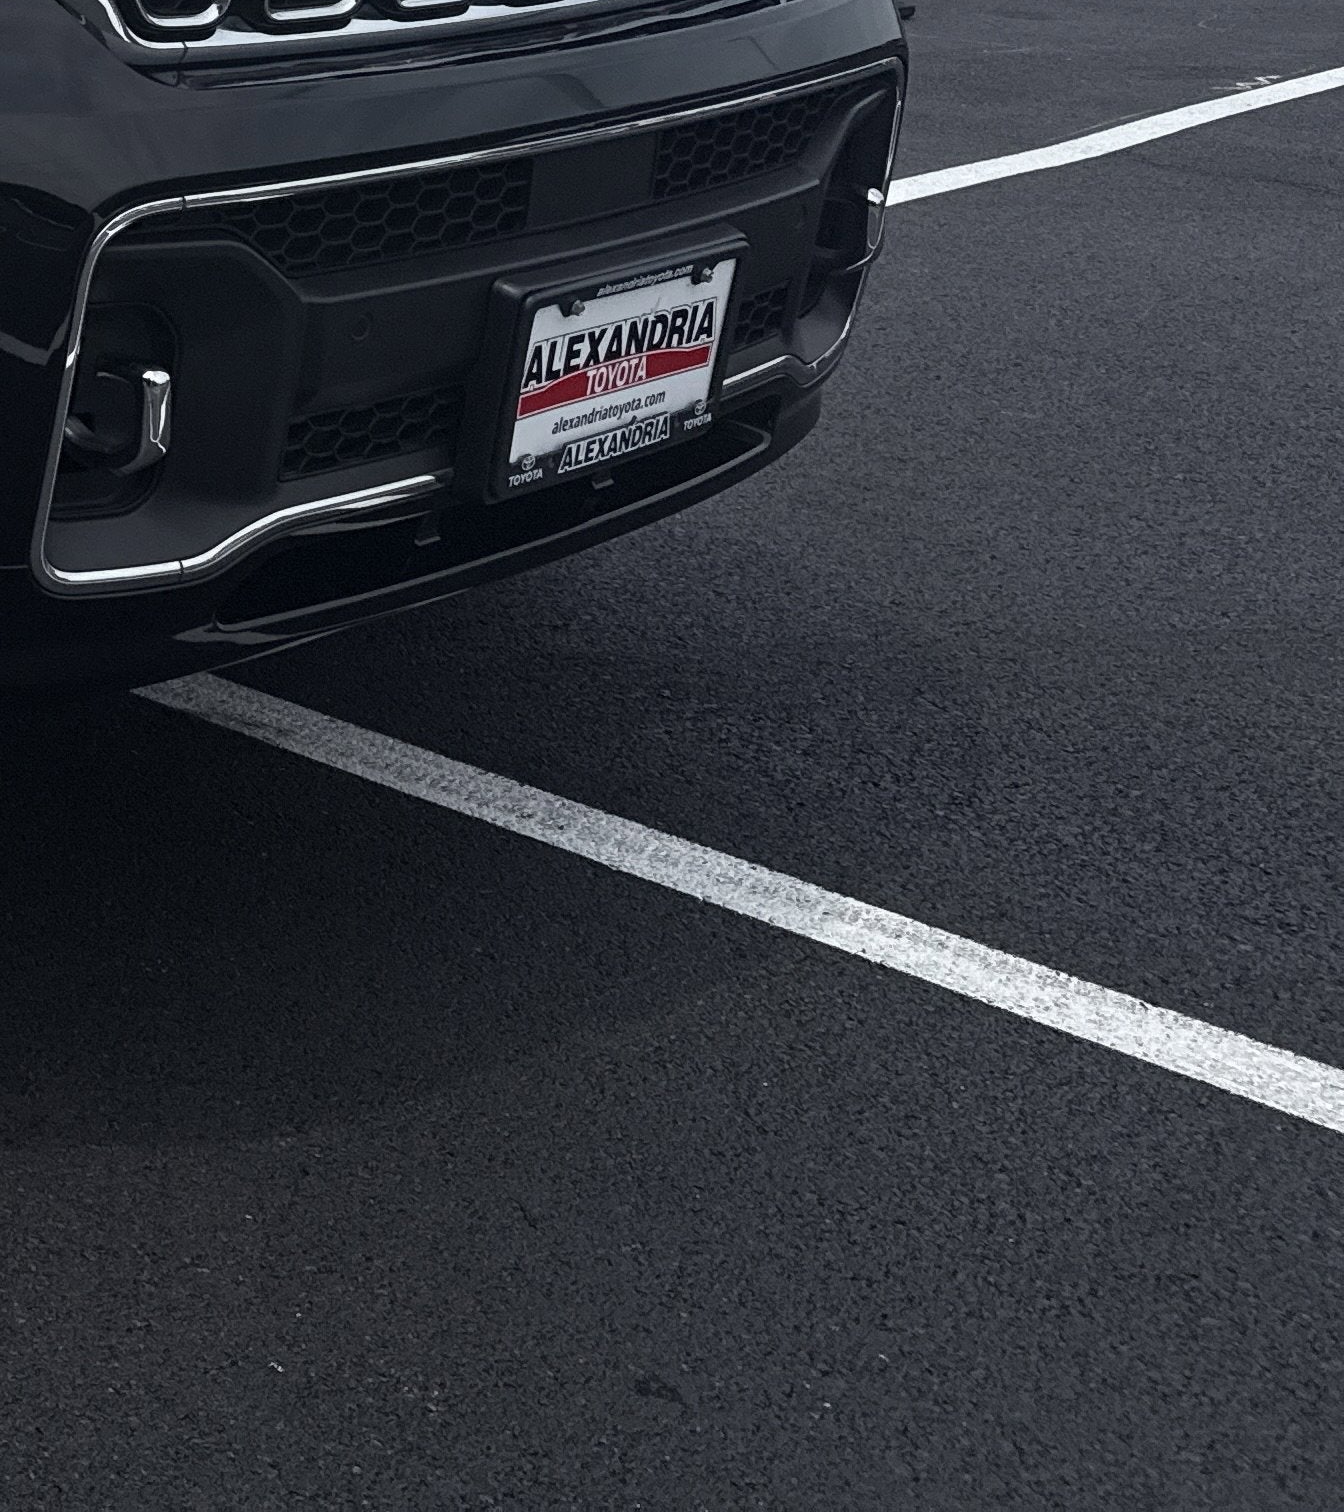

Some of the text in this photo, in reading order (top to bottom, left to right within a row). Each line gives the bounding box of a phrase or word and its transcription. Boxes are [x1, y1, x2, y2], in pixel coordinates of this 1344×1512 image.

[522, 299, 715, 390] ALEXANDRIA
[585, 358, 648, 396] TOYOTA
[551, 390, 666, 435] alexandriatoyota.com
[683, 413, 712, 431] TOYOTA
[558, 416, 670, 474] ALEXANDRIA
[508, 468, 544, 488] TOYOTA
